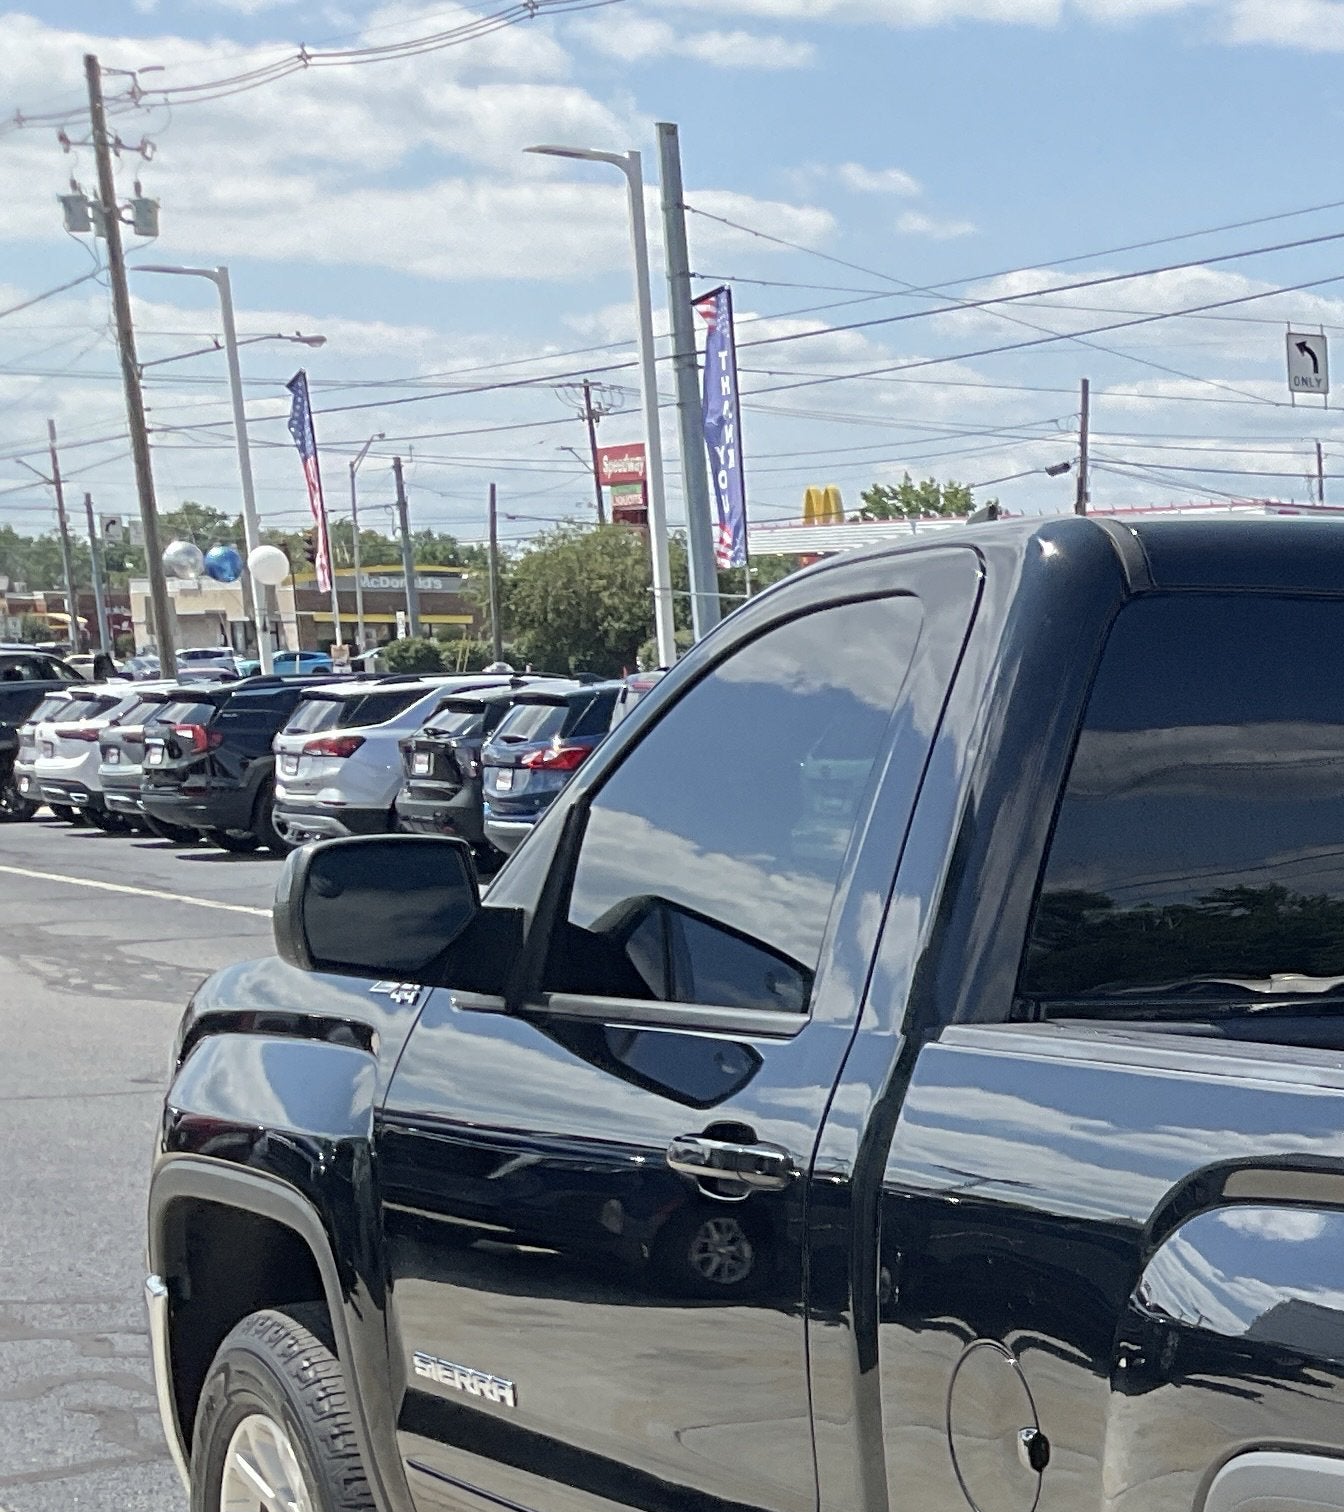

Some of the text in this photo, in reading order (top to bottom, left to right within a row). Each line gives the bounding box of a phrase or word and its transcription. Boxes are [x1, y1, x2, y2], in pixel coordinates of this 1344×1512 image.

[1293, 375, 1322, 388] ONLY
[602, 454, 644, 478] Speedway
[714, 446, 730, 515] YOU
[412, 1350, 517, 1408] SIERRA
